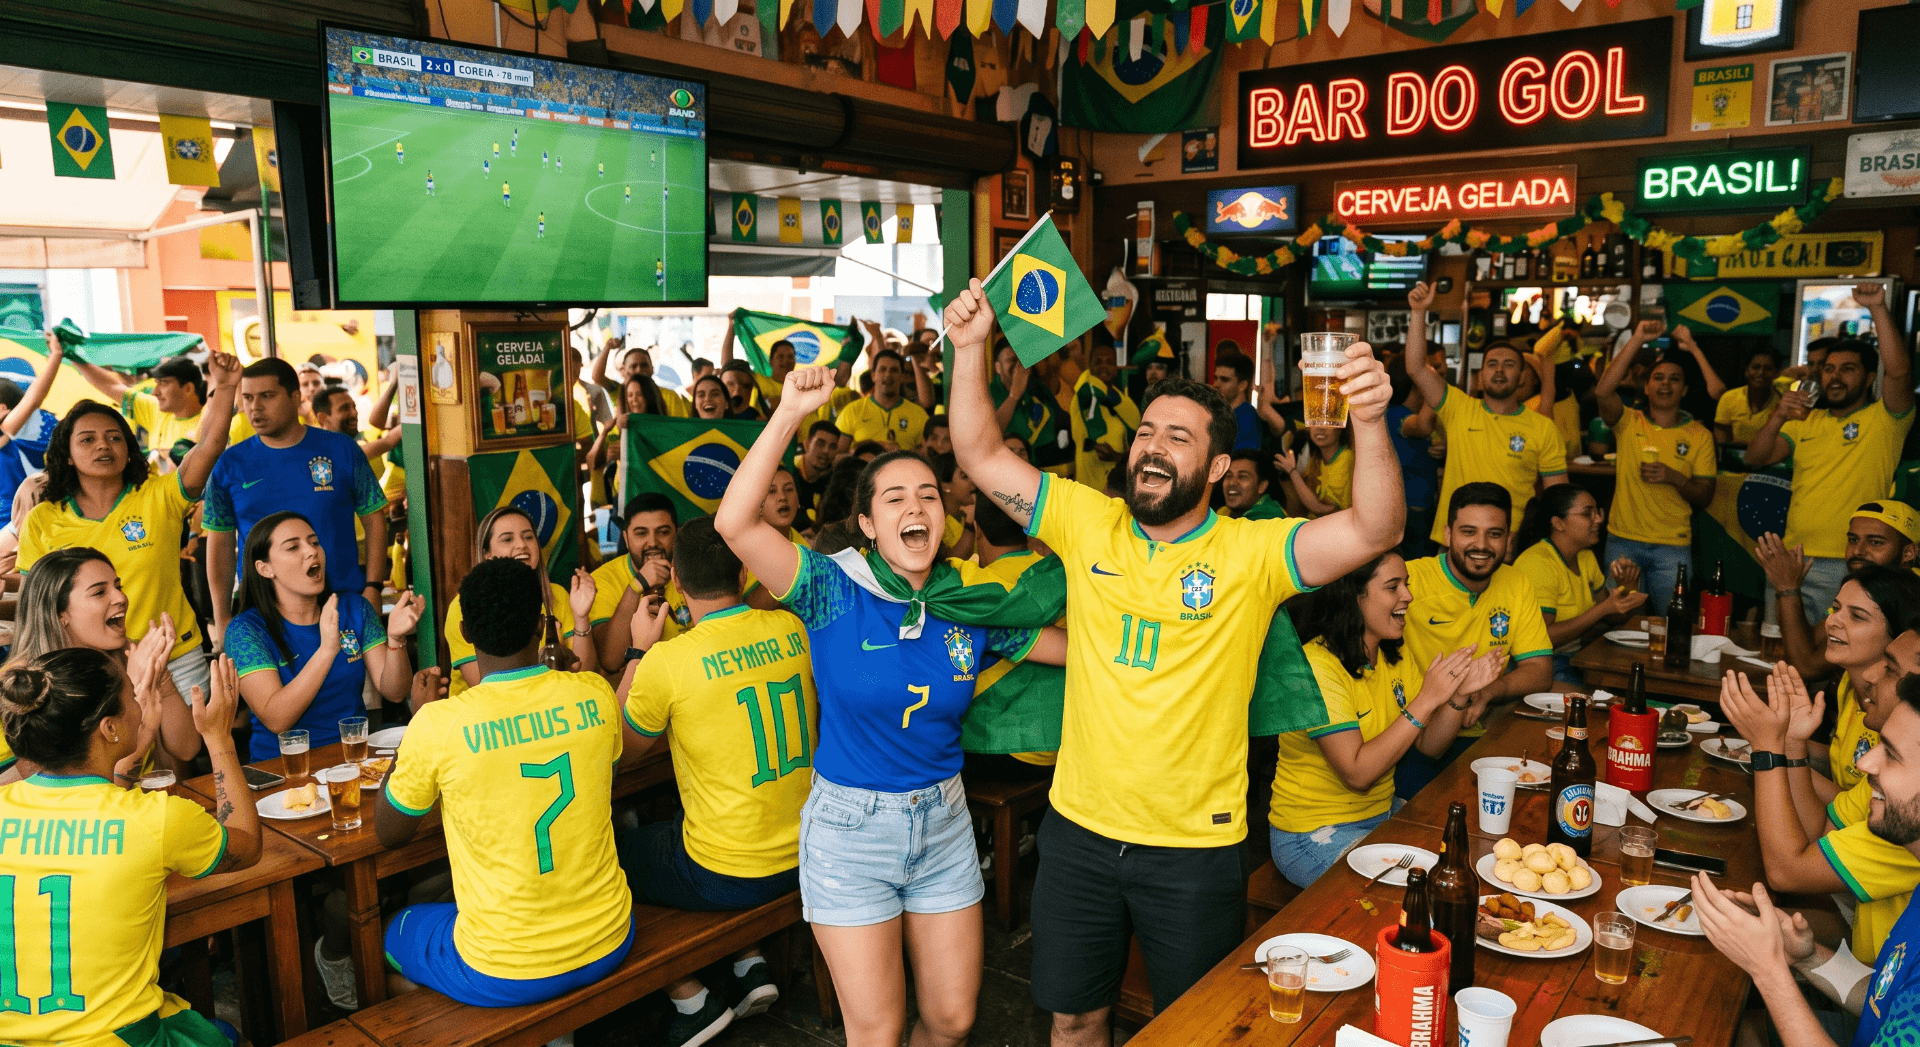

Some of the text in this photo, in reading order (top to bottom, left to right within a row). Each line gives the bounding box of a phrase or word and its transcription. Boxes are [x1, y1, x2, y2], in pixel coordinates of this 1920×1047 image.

[378, 53, 416, 67] BRASIL
[426, 60, 433, 71] 2
[443, 62, 451, 73] 0
[458, 65, 494, 78] COREIA
[501, 71, 512, 80] 78
[1698, 67, 1750, 83] BRASIL!
[668, 107, 696, 119] BAND
[1249, 47, 1645, 148] BAR DO GOL
[1337, 178, 1572, 217] CERVEJA GELADA
[1643, 158, 1800, 200] BRASIL!
[496, 342, 544, 353] CERVEJA
[496, 353, 545, 365] GELADA!
[701, 632, 807, 680] NEYMAR JR
[1113, 614, 1161, 671] 10
[463, 699, 606, 754] VINICIUS JR.
[902, 683, 930, 729] 7
[736, 673, 811, 789] 10
[1607, 745, 1651, 767] BRAHMA
[520, 751, 576, 875] 7
[0, 818, 125, 855] PHINHA
[0, 875, 86, 1015] 11
[1410, 984, 1435, 1047] BRAHMA
